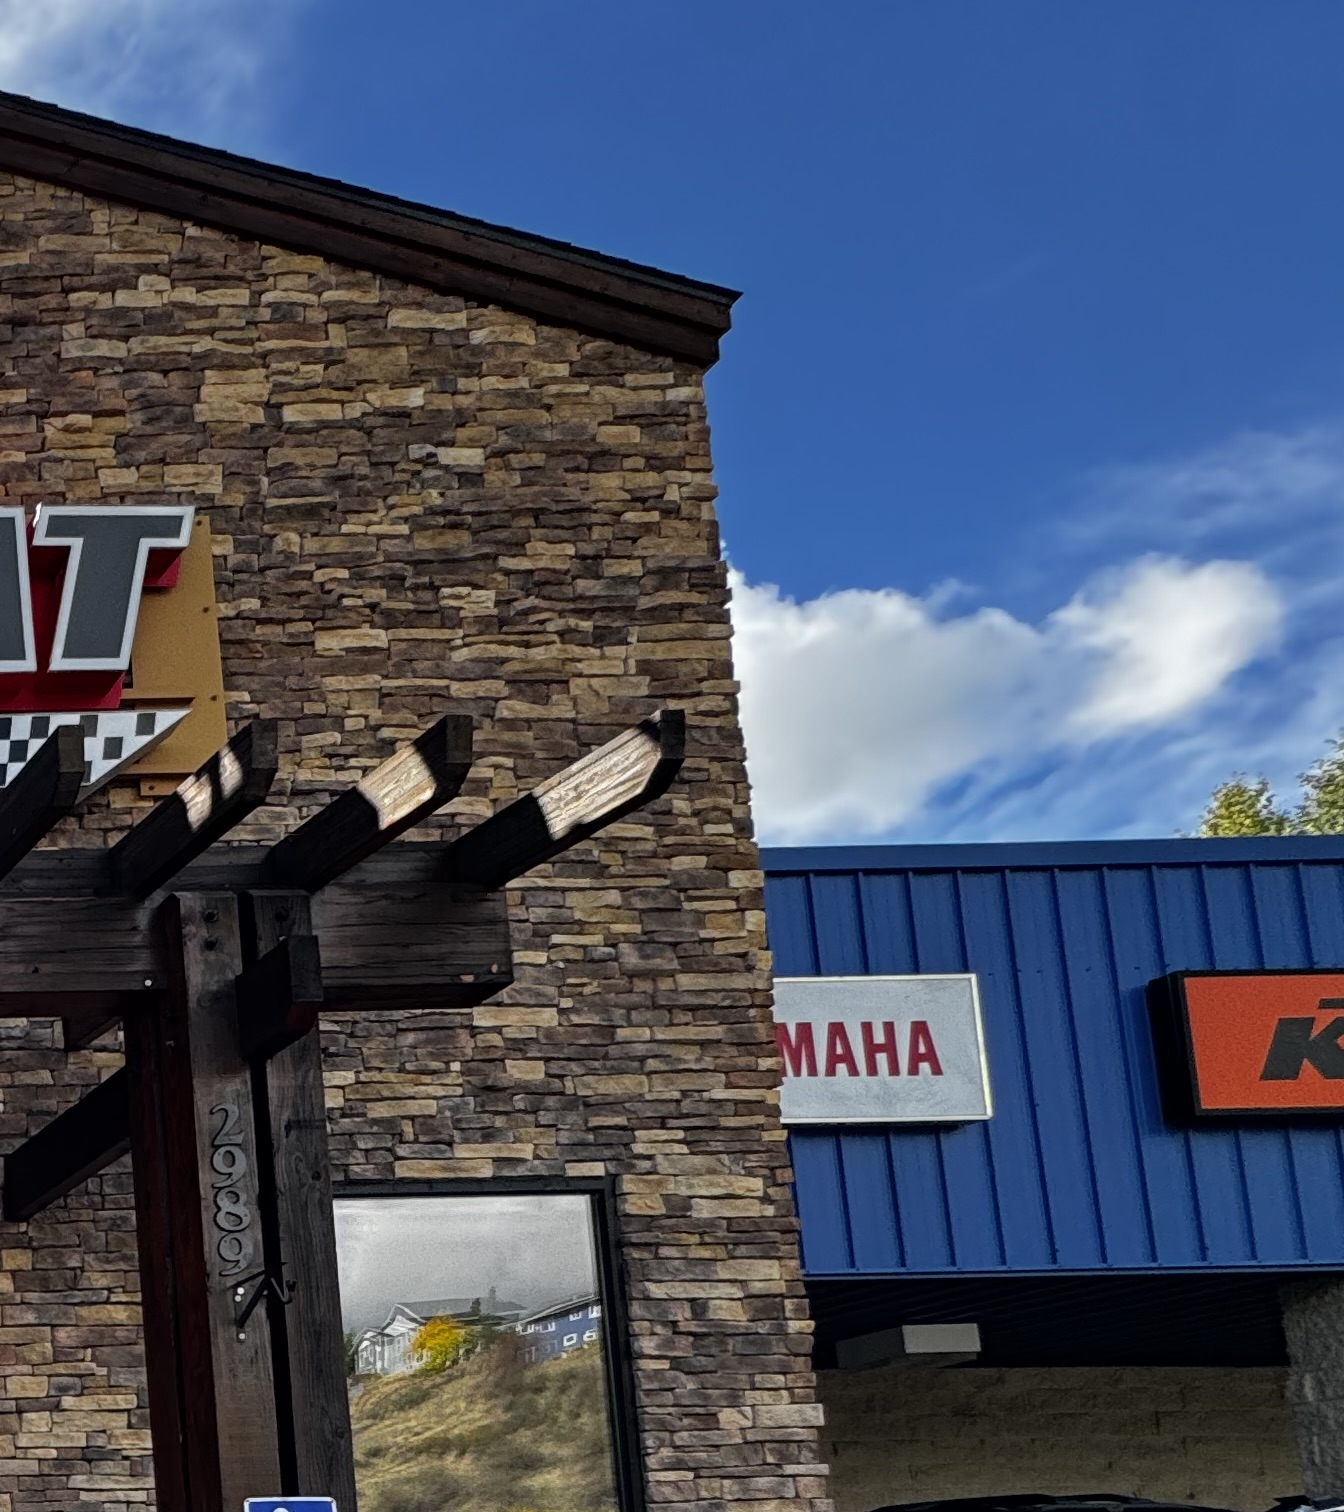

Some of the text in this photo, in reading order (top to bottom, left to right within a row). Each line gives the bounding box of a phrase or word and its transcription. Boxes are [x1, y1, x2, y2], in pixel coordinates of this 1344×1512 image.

[775, 1021, 944, 1078] MAHA
[1258, 997, 1344, 1081] K
[210, 1102, 254, 1277] 2989
